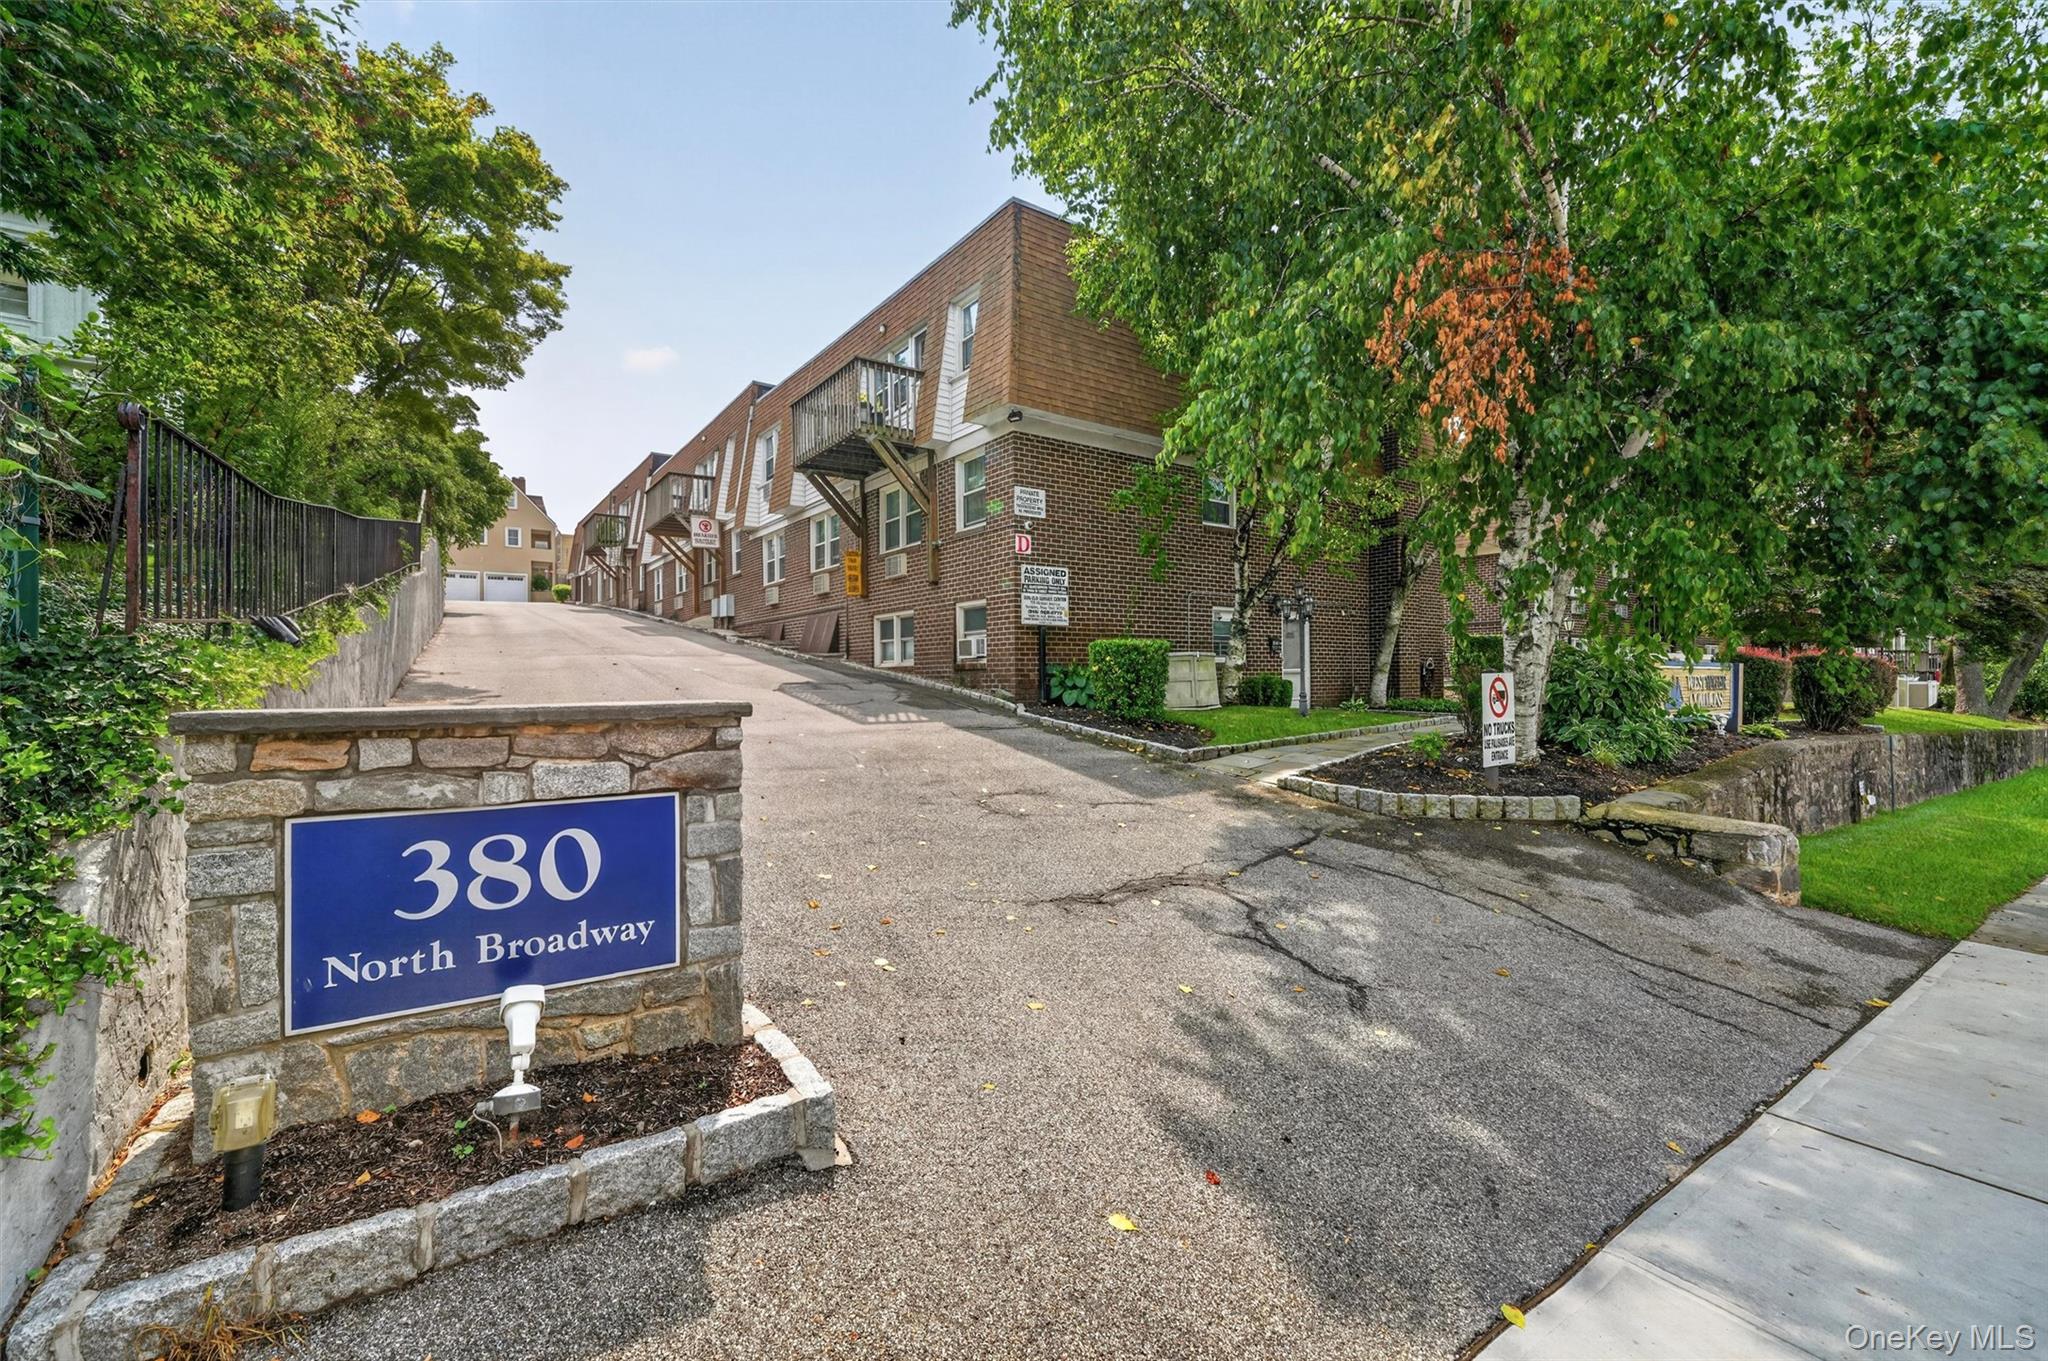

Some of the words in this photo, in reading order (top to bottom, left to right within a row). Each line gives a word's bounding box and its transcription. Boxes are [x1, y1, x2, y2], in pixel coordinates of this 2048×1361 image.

[1016, 495, 1043, 504] PROPERTY
[1017, 535, 1030, 552] D
[1024, 567, 1066, 577] ASSIGNED
[1024, 575, 1050, 584] PARKING
[1051, 577, 1066, 585] ONLY
[1483, 723, 1492, 736] NO
[1493, 721, 1515, 735] TRUCKS
[393, 827, 602, 921] 380
[322, 939, 456, 989] North
[475, 919, 655, 965] Broadway
